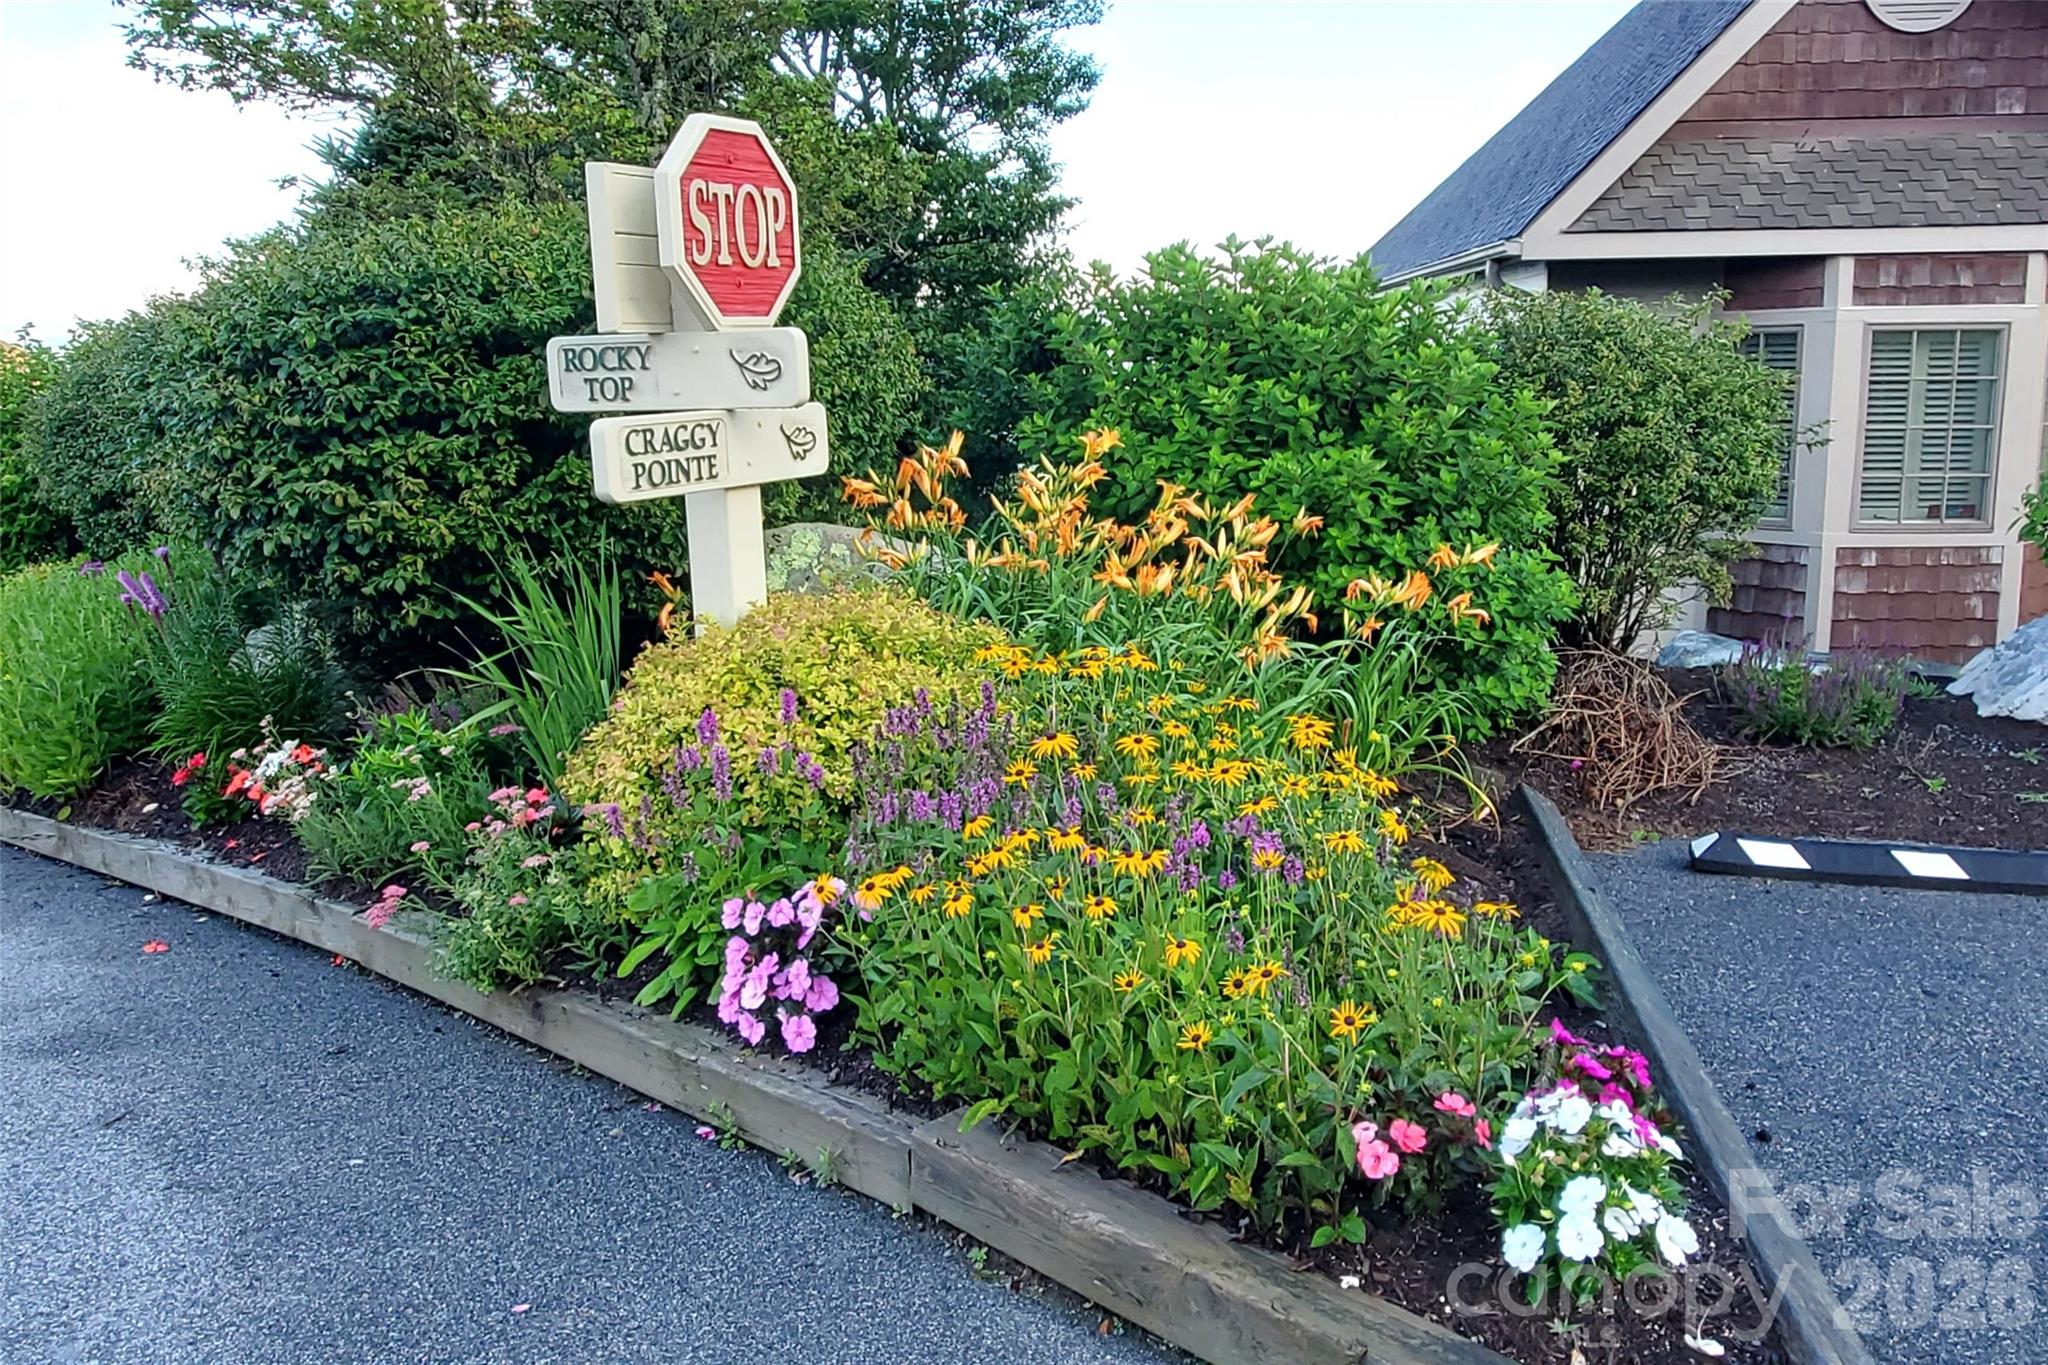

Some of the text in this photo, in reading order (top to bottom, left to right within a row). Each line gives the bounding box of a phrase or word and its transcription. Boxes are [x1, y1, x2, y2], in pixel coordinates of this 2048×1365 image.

[689, 178, 786, 268] STOP
[562, 345, 651, 372] ROCKY
[583, 376, 634, 402] TOP
[625, 421, 721, 457] CRAGGY
[632, 456, 719, 490] POINTE
